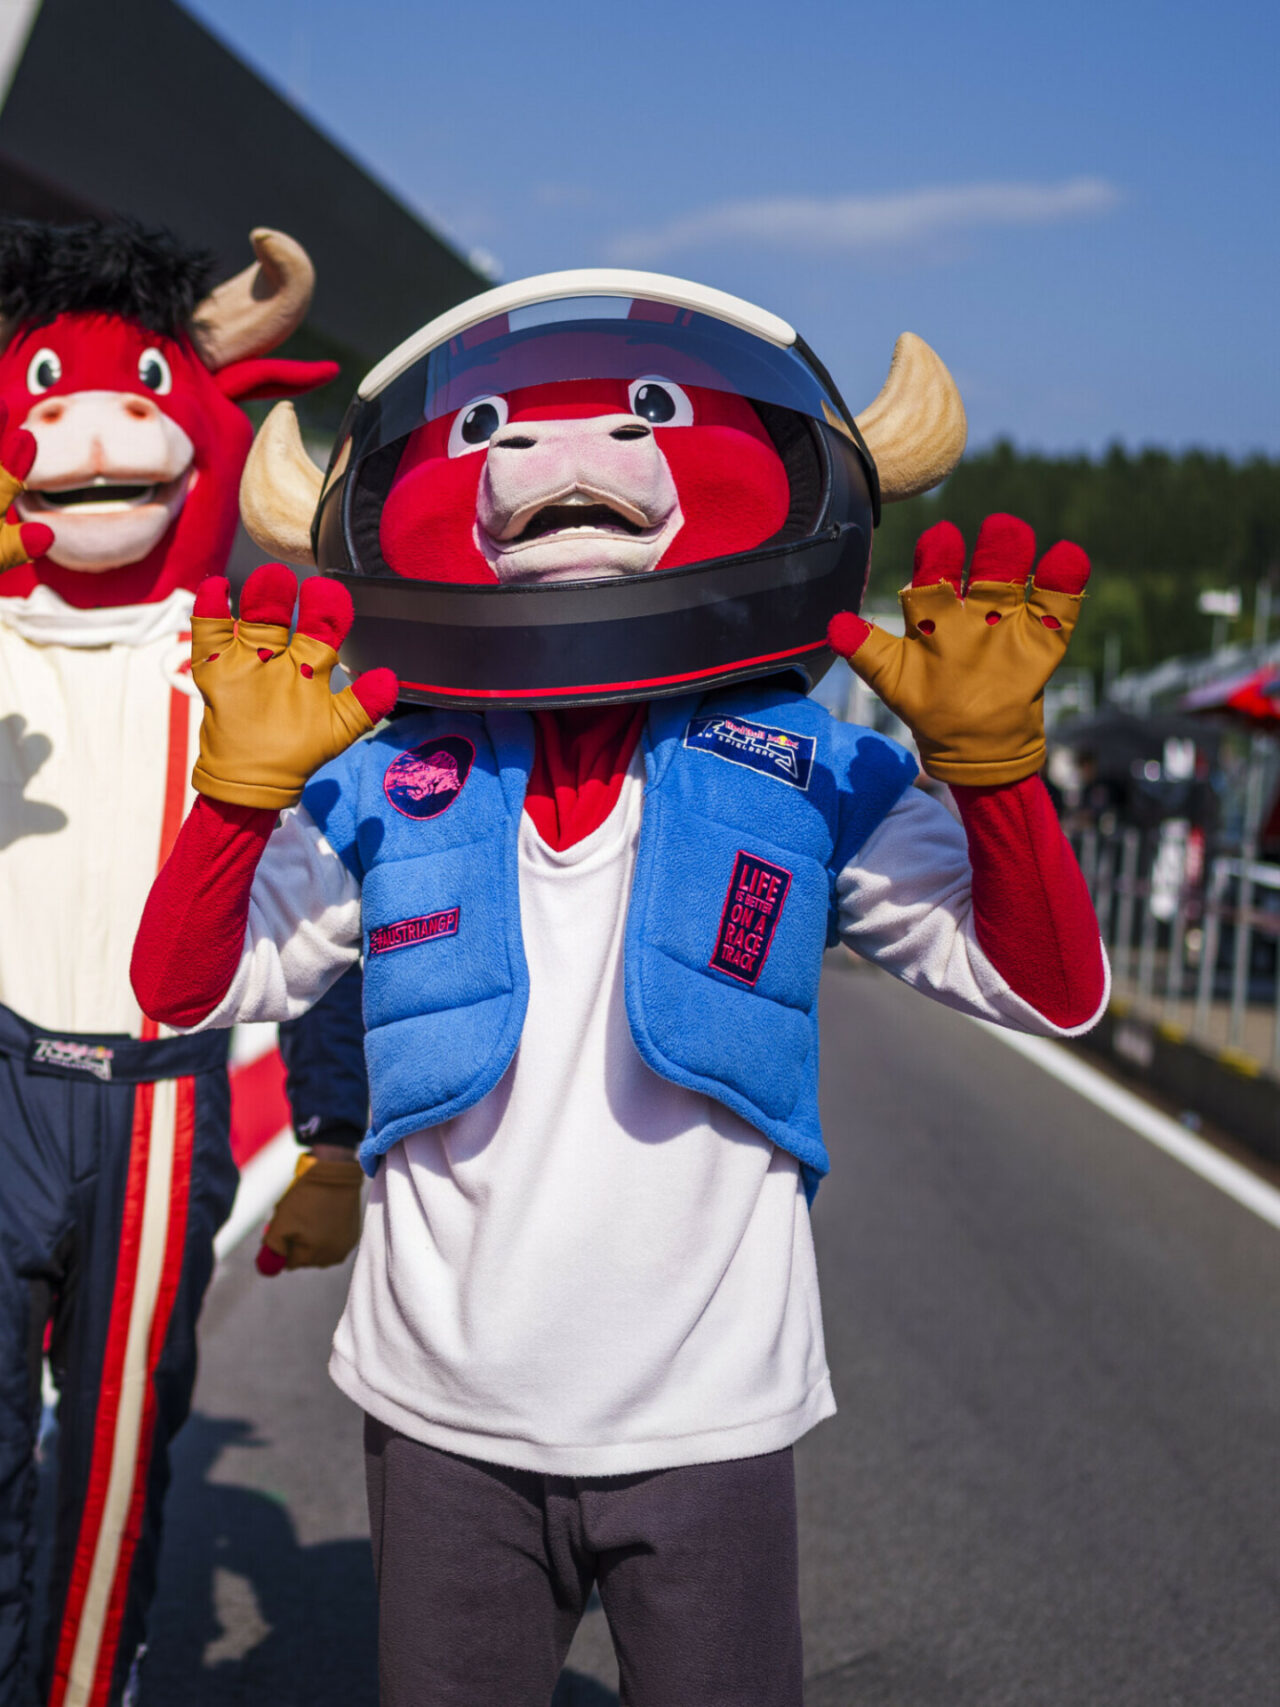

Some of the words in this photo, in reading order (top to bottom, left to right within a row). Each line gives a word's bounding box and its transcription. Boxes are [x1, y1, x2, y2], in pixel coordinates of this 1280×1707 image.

[725, 720, 745, 736] Red
[745, 727, 766, 740] Bull
[718, 735, 775, 758] SPIELBERG
[738, 864, 782, 903] LIFE
[735, 890, 745, 902] IS
[744, 893, 773, 915] BETTER
[376, 914, 455, 948] #AUSTRIANGP
[731, 904, 755, 928] ON
[754, 914, 767, 935] A
[724, 922, 763, 956] RACE
[721, 943, 757, 972] TRACK
